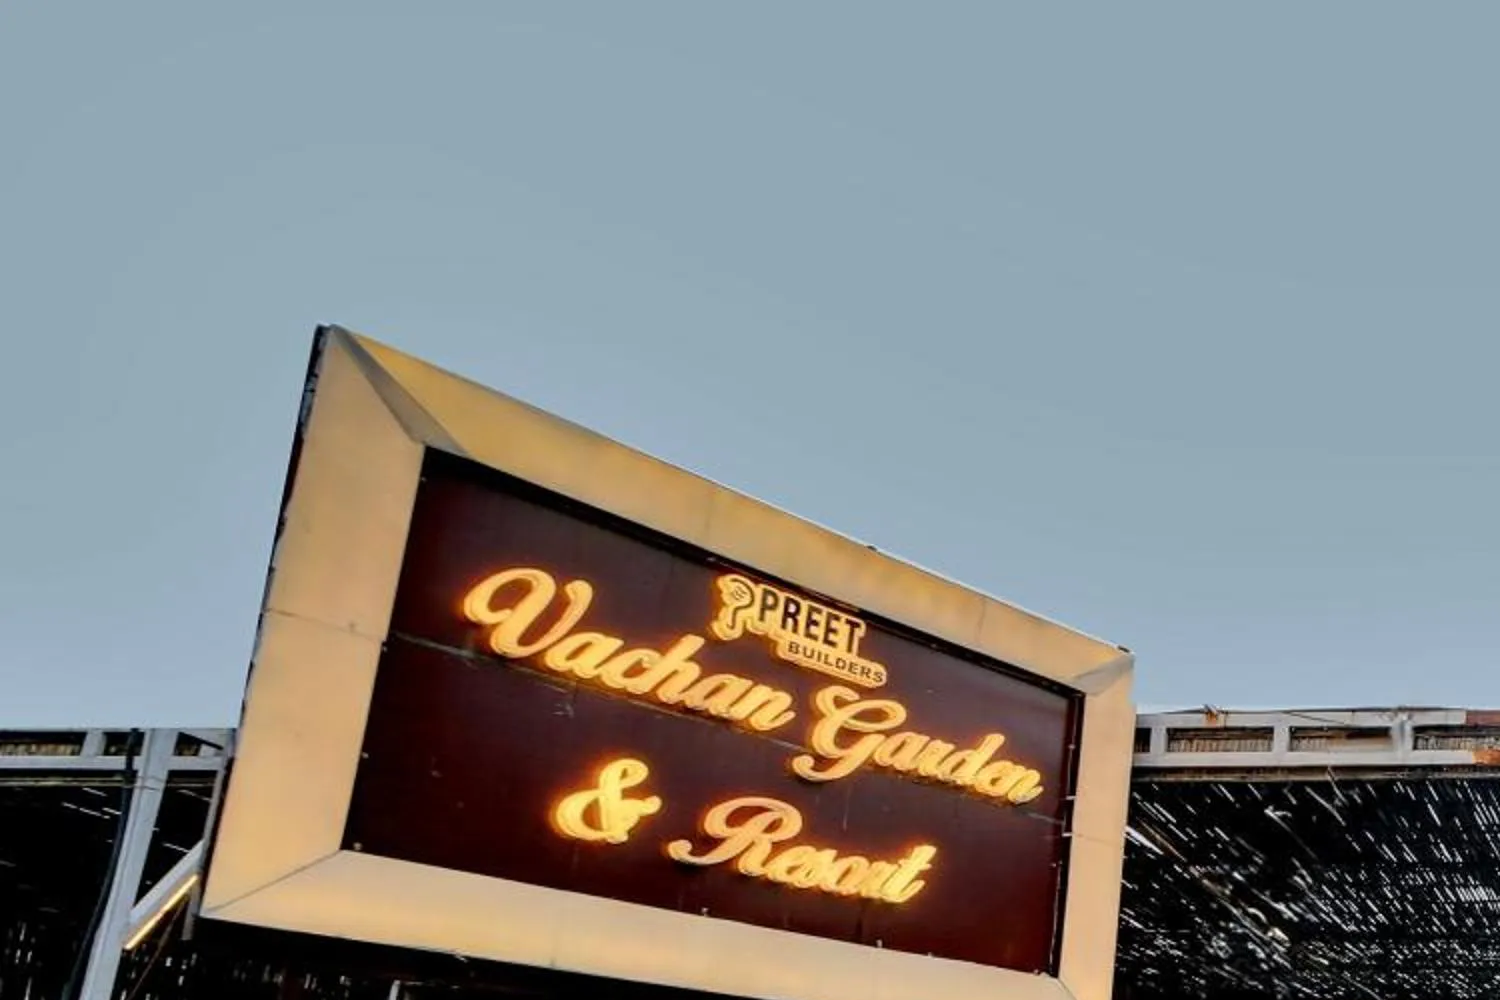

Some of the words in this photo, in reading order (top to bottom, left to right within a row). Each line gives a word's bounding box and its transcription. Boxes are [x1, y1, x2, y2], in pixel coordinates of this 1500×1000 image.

[759, 588, 862, 653] PREET
[788, 641, 884, 683] BUILDERS
[463, 567, 796, 731] Vachan
[793, 686, 1044, 801] Garden
[556, 759, 661, 842] &
[666, 797, 936, 903] Resort
